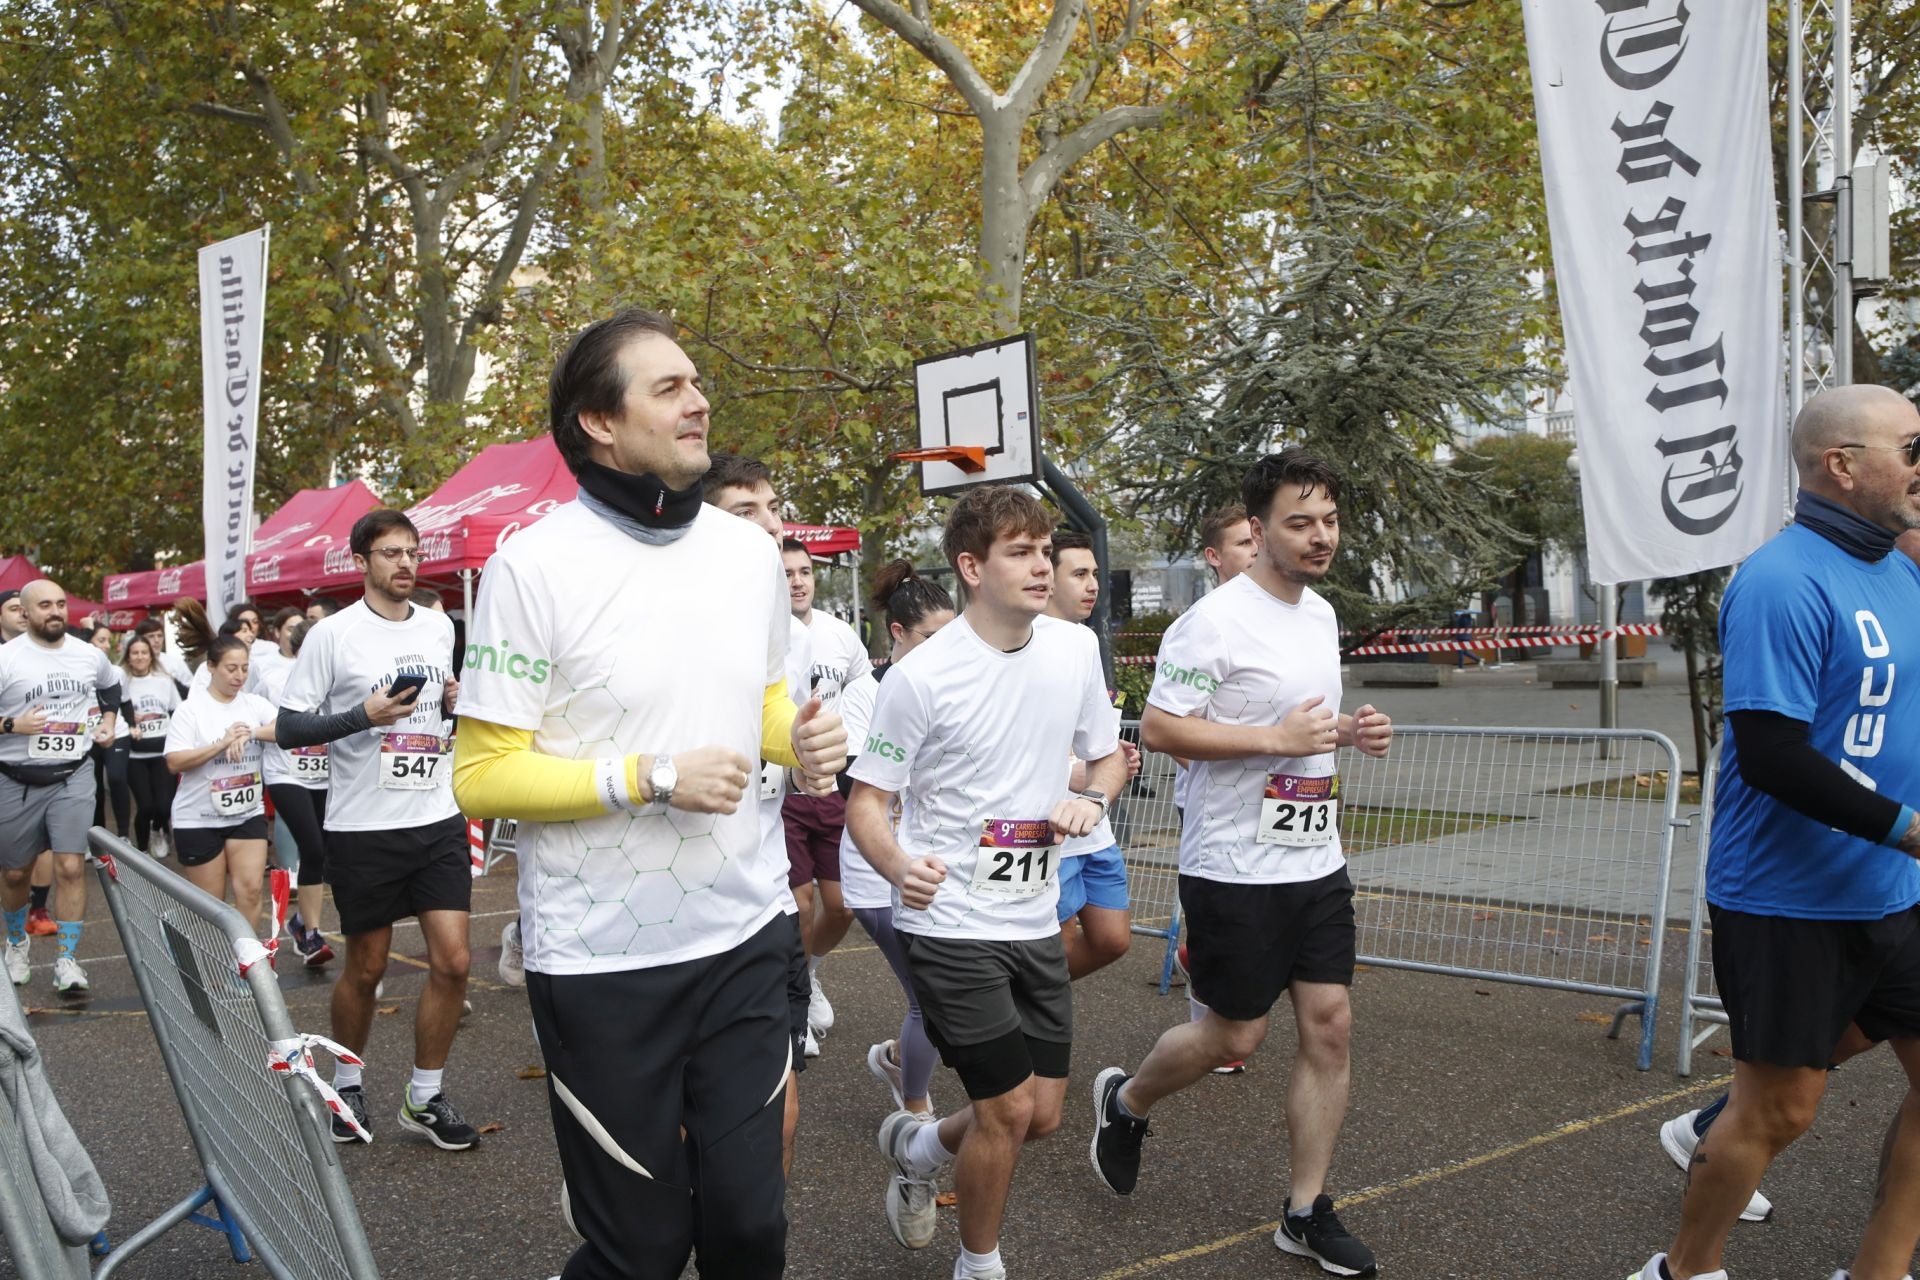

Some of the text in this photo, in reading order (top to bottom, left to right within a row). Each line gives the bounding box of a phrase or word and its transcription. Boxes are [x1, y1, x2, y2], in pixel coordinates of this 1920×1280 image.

[37, 736, 76, 752] 539
[392, 755, 439, 778] 547
[1285, 777, 1298, 791] 9ª
[221, 788, 255, 808] 540
[1271, 803, 1329, 833] 213
[1001, 822, 1015, 837] 9ª
[1014, 829, 1046, 839] EMPRESAS
[987, 850, 1050, 882] 211
